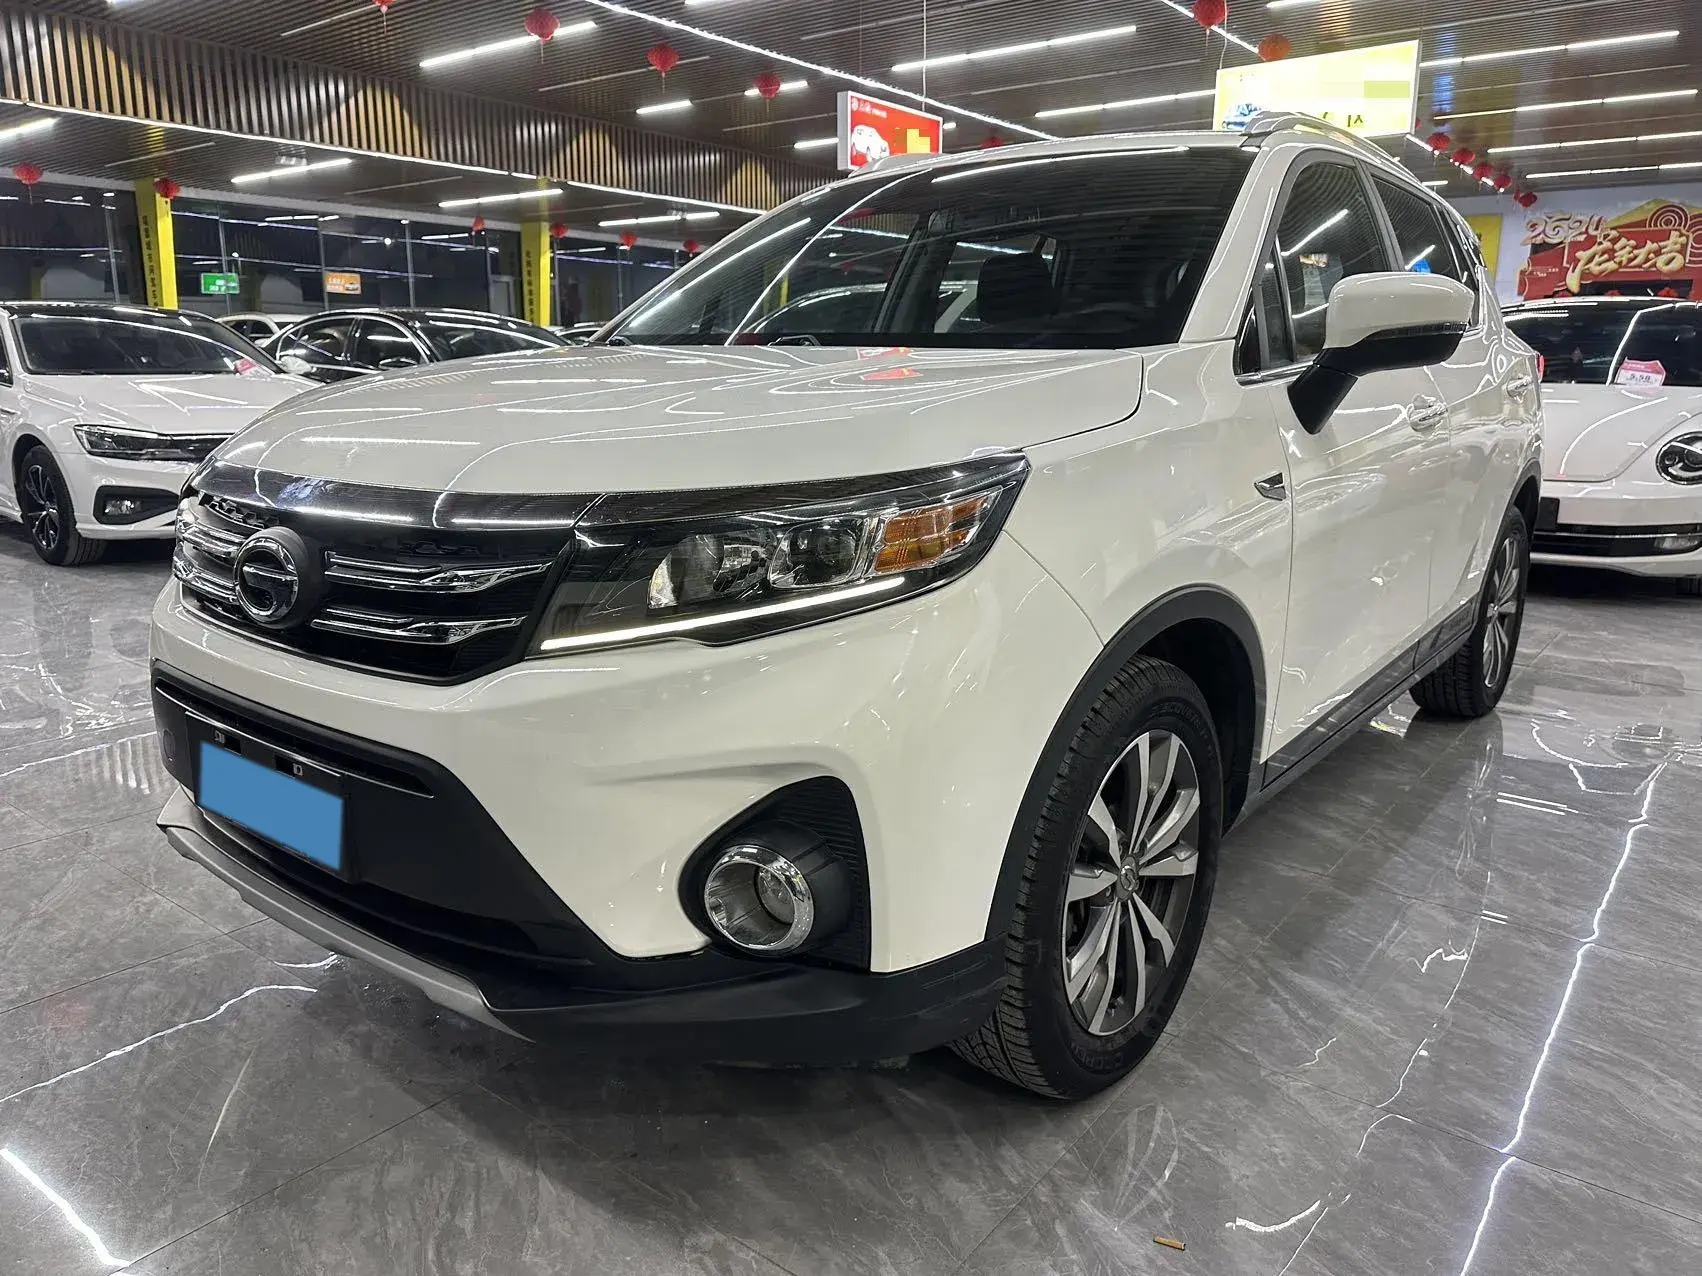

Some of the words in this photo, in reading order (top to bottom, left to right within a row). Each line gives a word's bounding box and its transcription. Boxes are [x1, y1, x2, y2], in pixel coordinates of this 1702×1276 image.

[1521, 213, 1608, 246] 2024
[1566, 230, 1687, 293] 龙年大吉
